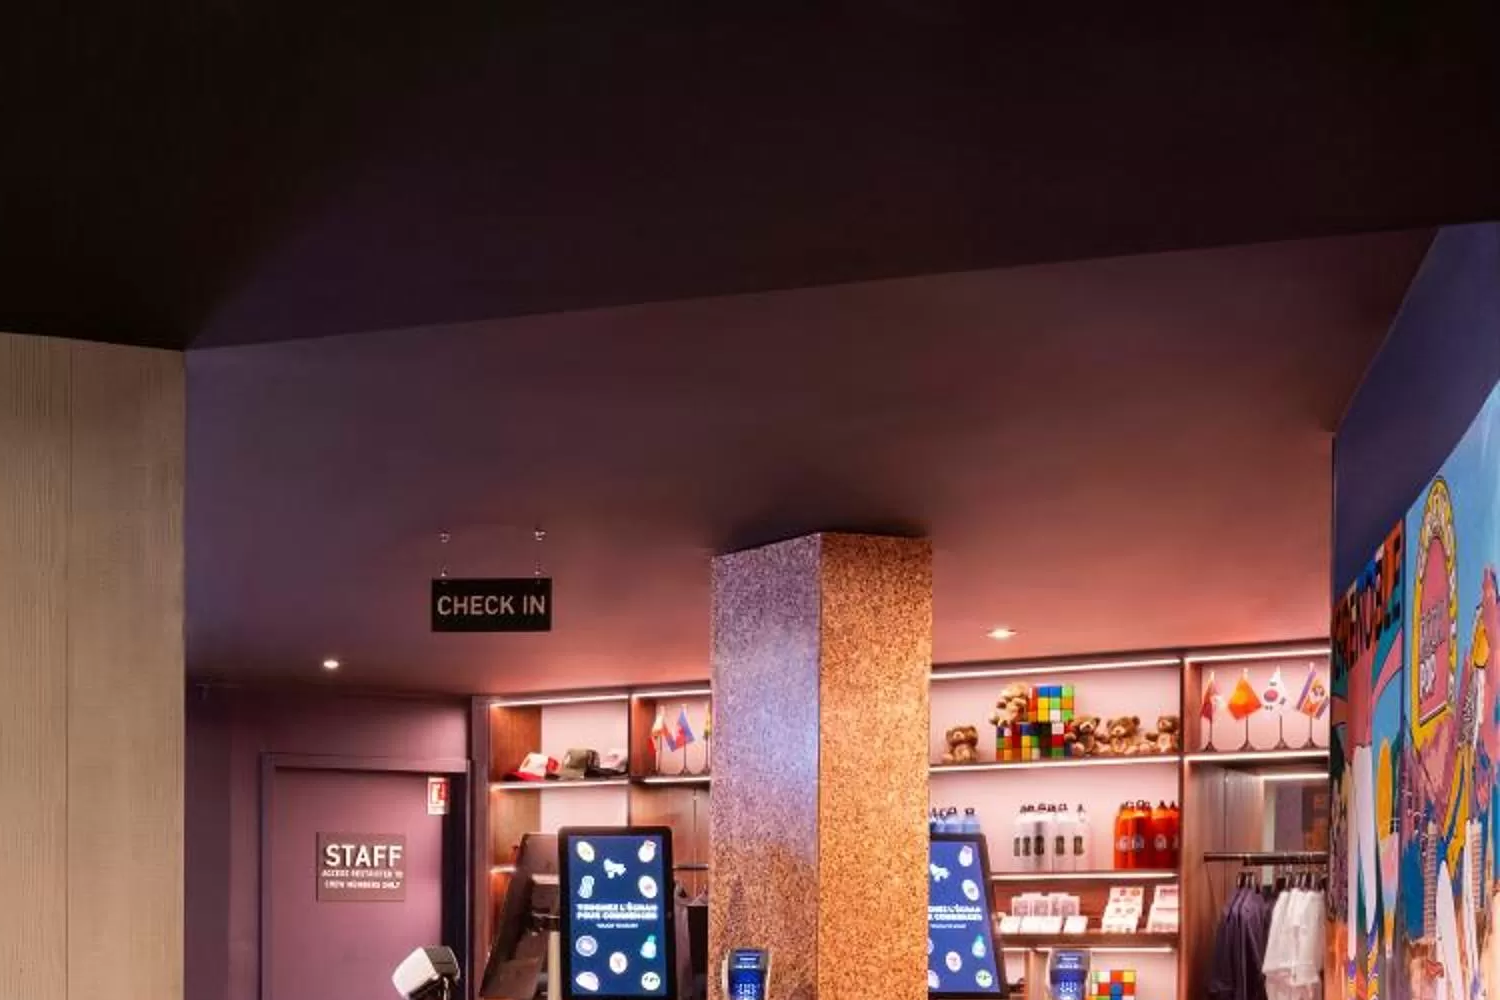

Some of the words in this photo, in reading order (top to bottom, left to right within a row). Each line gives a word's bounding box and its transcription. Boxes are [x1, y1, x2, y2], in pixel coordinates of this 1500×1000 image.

[437, 595, 515, 615] CHECK
[523, 595, 545, 615] IN
[325, 844, 403, 867] STAFF
